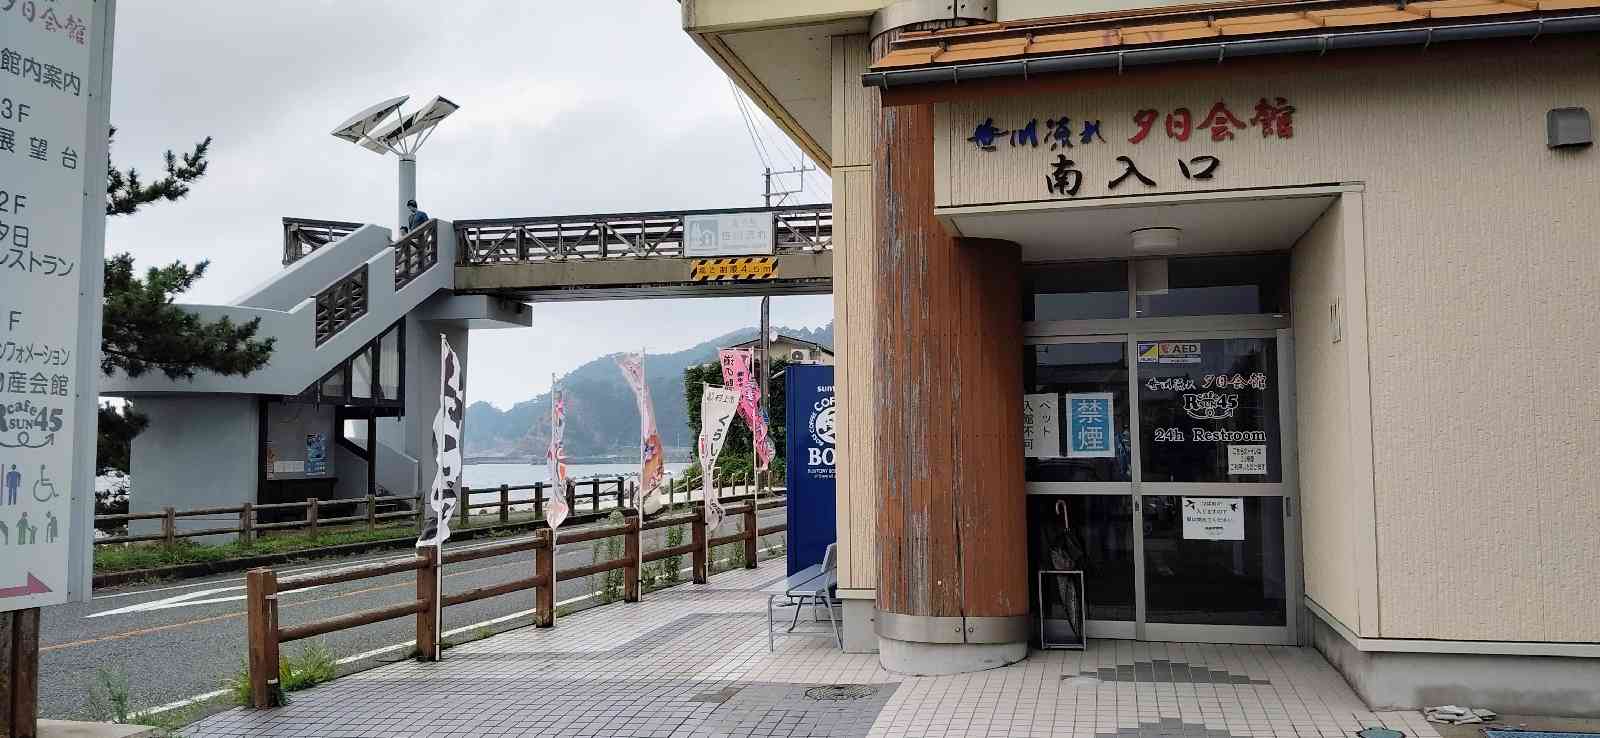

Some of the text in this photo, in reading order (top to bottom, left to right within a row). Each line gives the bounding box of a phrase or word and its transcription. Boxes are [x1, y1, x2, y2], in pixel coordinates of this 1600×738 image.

[0, 48, 80, 96] 館内案内
[1, 98, 31, 122] 3F
[967, 97, 1296, 151] 笹川流れ 夕日会館
[1046, 153, 1220, 196] 南入口
[1172, 344, 1197, 353] AED
[0, 371, 69, 396] 産会館
[1201, 372, 1267, 390] 夕日会館
[33, 407, 63, 432] 45
[1077, 399, 1104, 450] 禁煙
[1154, 427, 1267, 442] 24h Restroom
